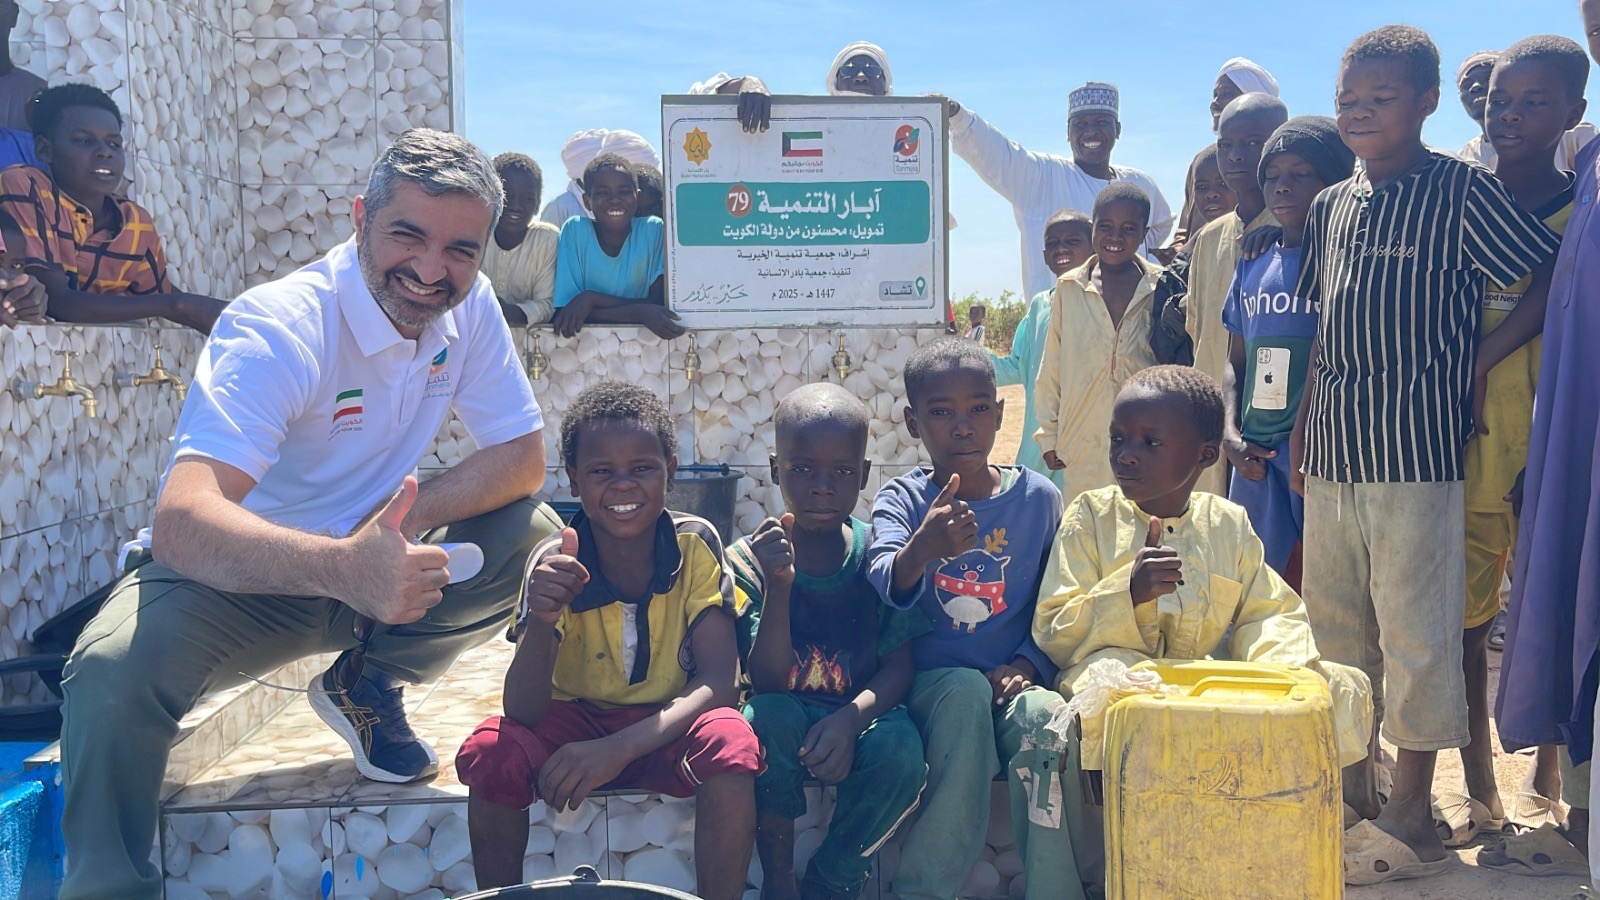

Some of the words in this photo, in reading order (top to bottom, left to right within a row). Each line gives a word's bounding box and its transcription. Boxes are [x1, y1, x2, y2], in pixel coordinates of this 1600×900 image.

[1270, 135, 1287, 154] A
[728, 191, 750, 212] 79
[757, 190, 836, 220] التنمية
[838, 188, 882, 220] آبار
[722, 222, 760, 240] الكويت
[760, 221, 785, 238] دولة
[785, 225, 800, 240] من
[802, 222, 847, 241] محسنون
[1348, 228, 1415, 265] Sunshine
[737, 249, 773, 261] الخيرية
[775, 249, 803, 261] تنمية
[805, 249, 835, 261] جمعية
[790, 268, 804, 279] بادر
[805, 268, 828, 279] جمعية
[778, 288, 798, 299] 2025
[816, 288, 836, 299] 1447
[884, 284, 913, 296] تشاد
